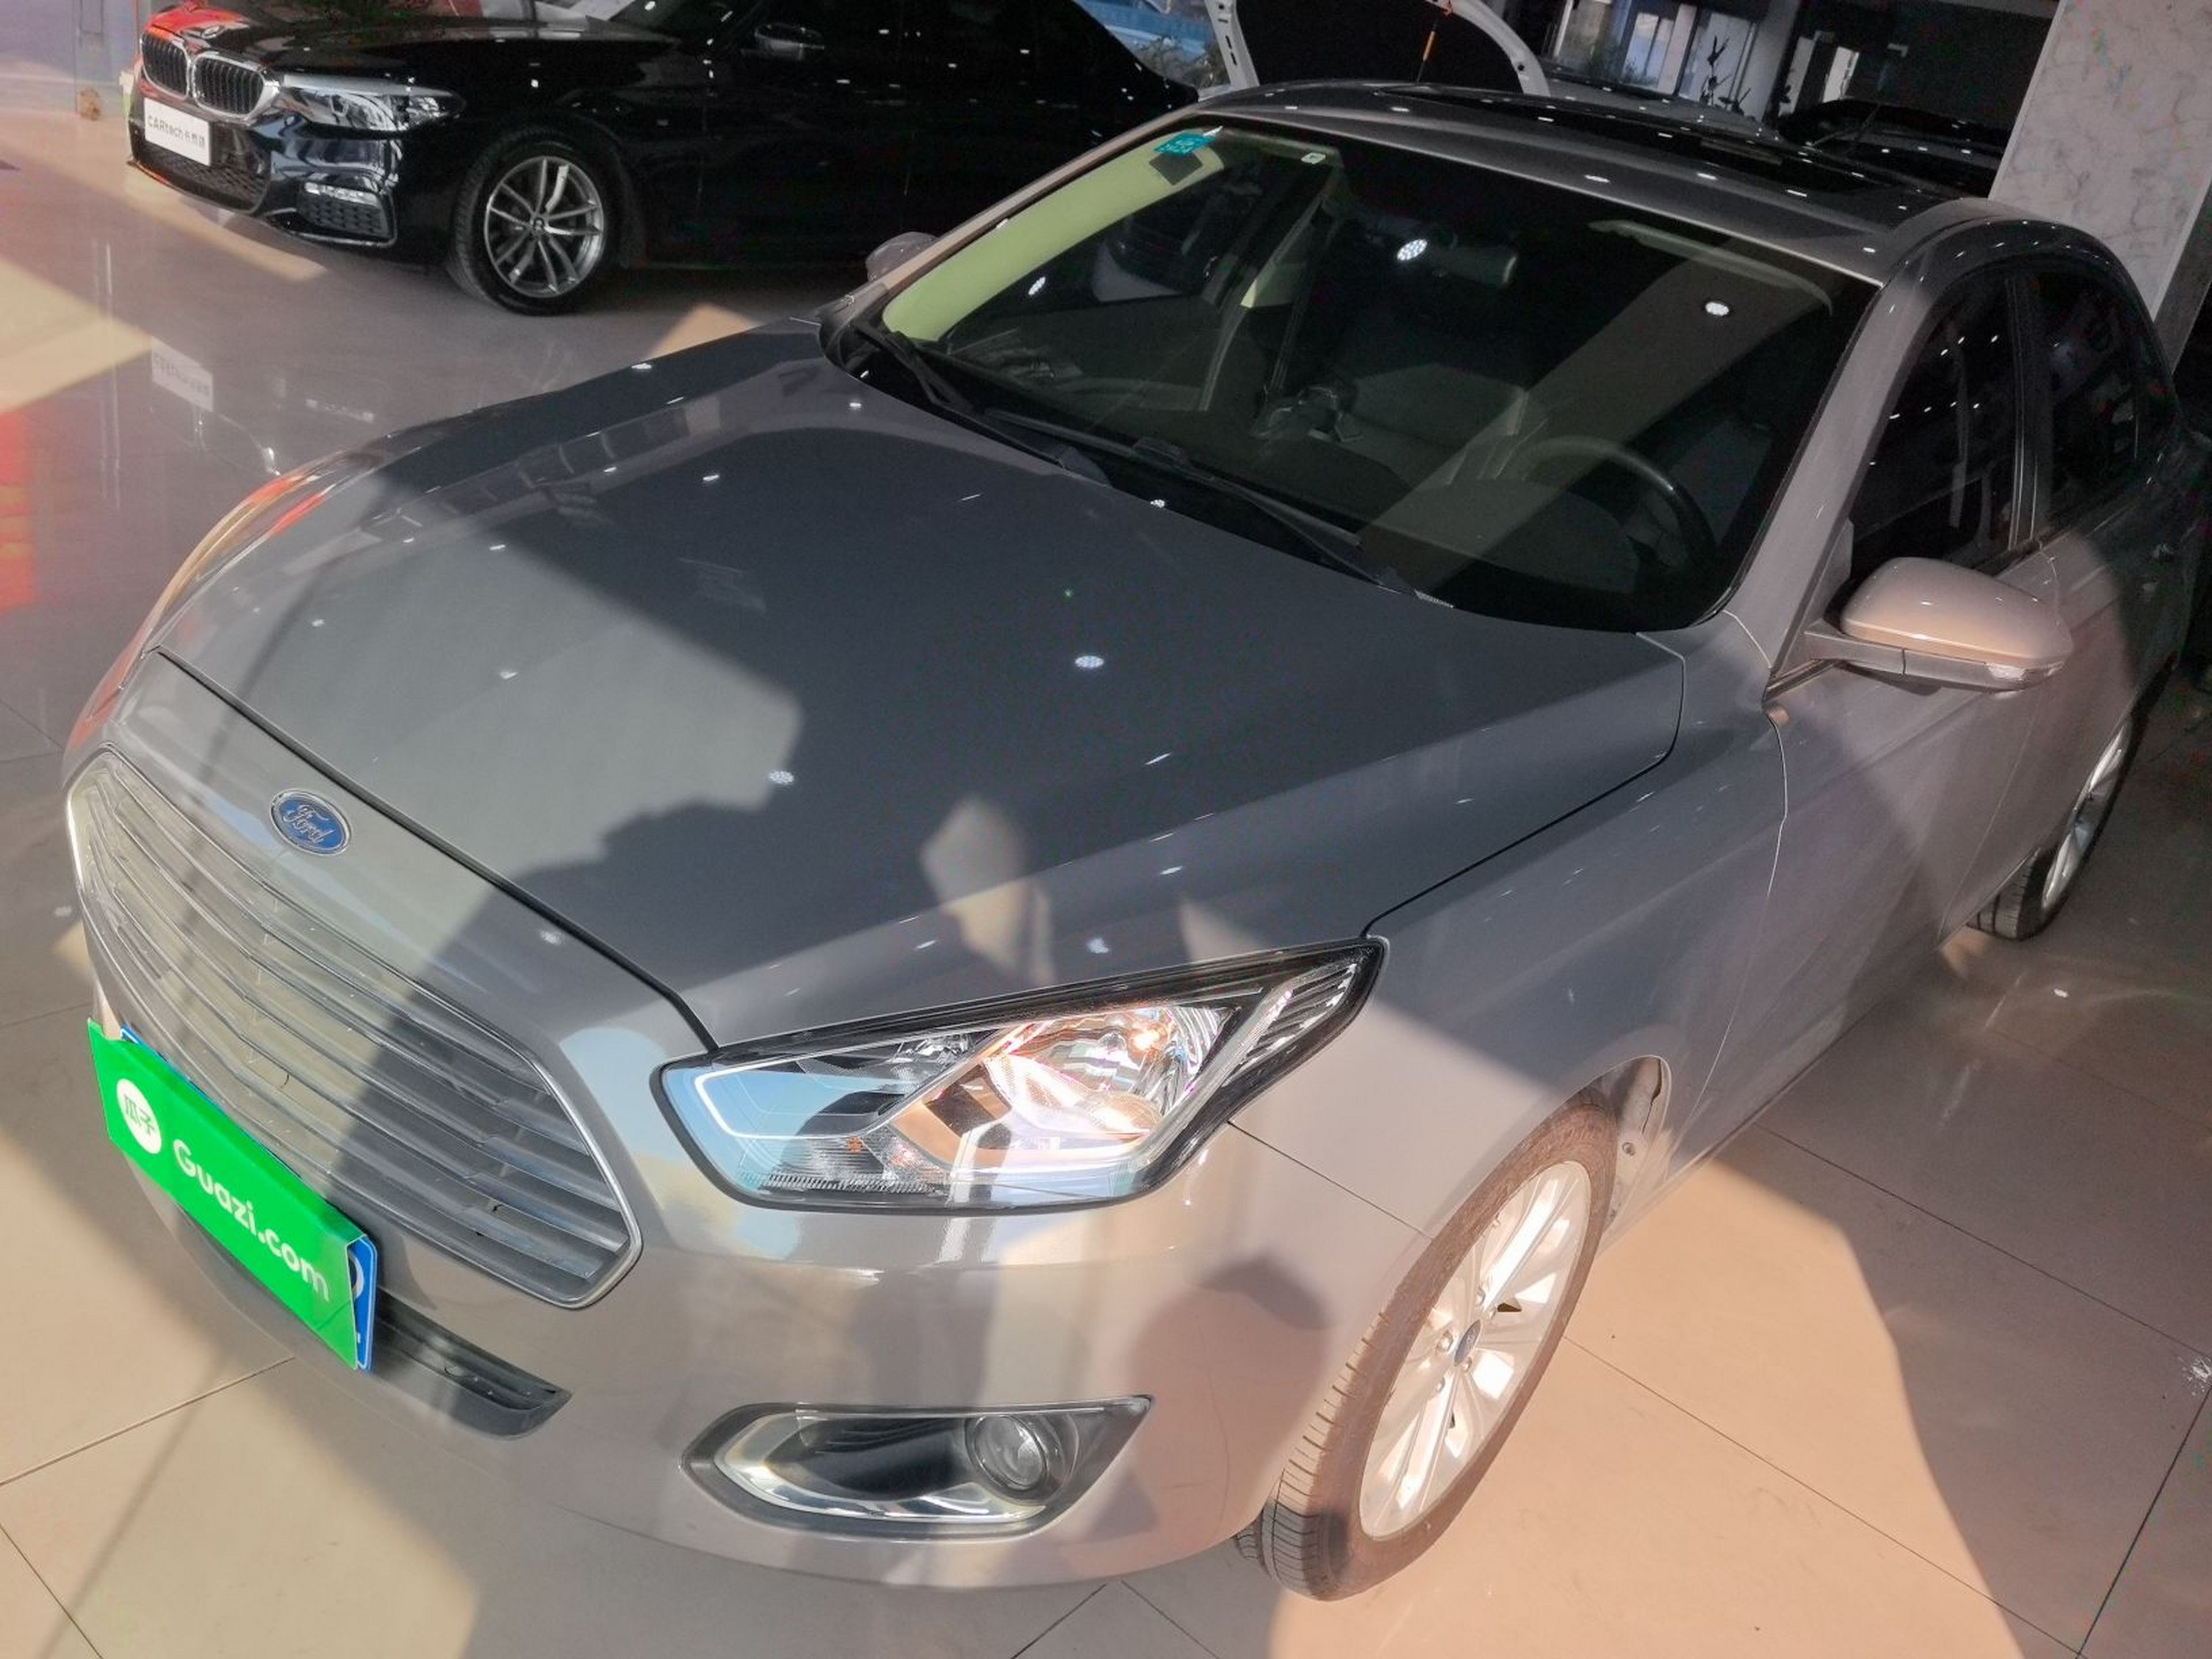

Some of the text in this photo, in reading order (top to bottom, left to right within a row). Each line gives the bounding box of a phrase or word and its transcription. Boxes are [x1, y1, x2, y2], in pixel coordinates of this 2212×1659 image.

[283, 804, 335, 843] Ford
[123, 1094, 155, 1136] 瓜子
[173, 1139, 330, 1302] Guazi.com
